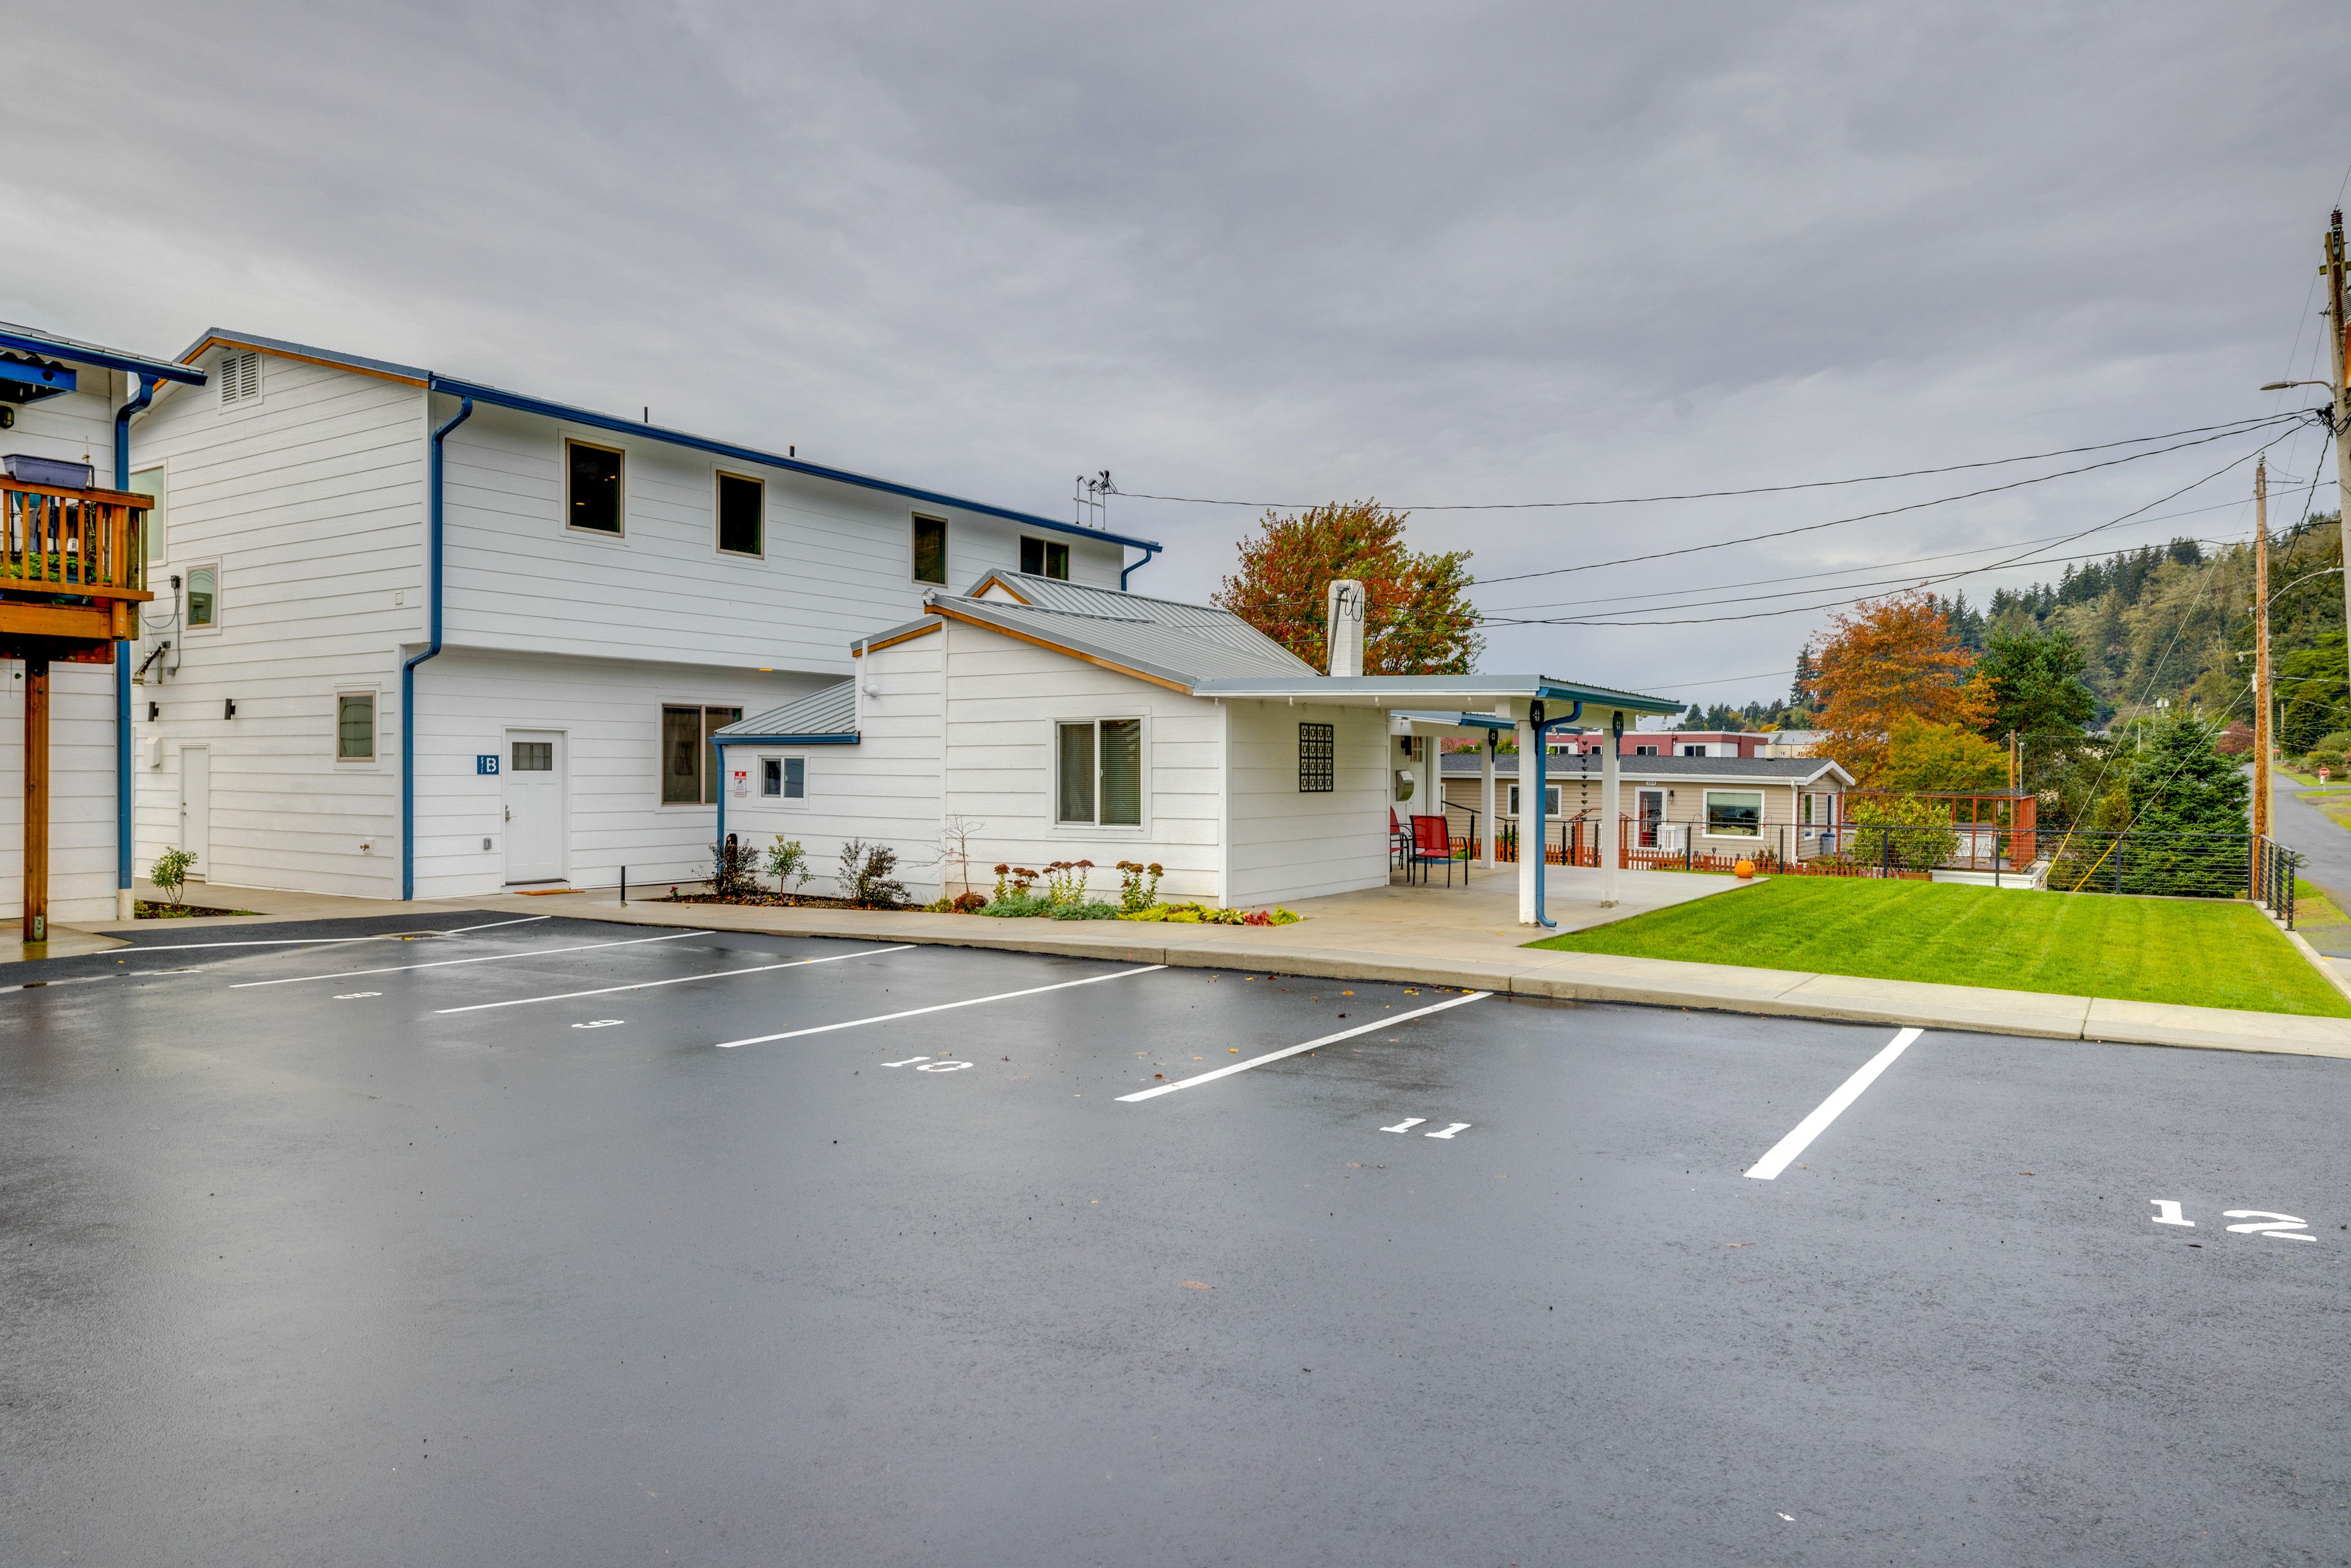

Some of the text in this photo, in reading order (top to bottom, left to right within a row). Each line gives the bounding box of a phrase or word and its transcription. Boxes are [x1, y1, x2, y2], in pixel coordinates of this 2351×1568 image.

[486, 757, 497, 772] B
[880, 1056, 973, 1073] 10
[1379, 1117, 1471, 1139] 11
[2150, 1199, 2317, 1242] 12
